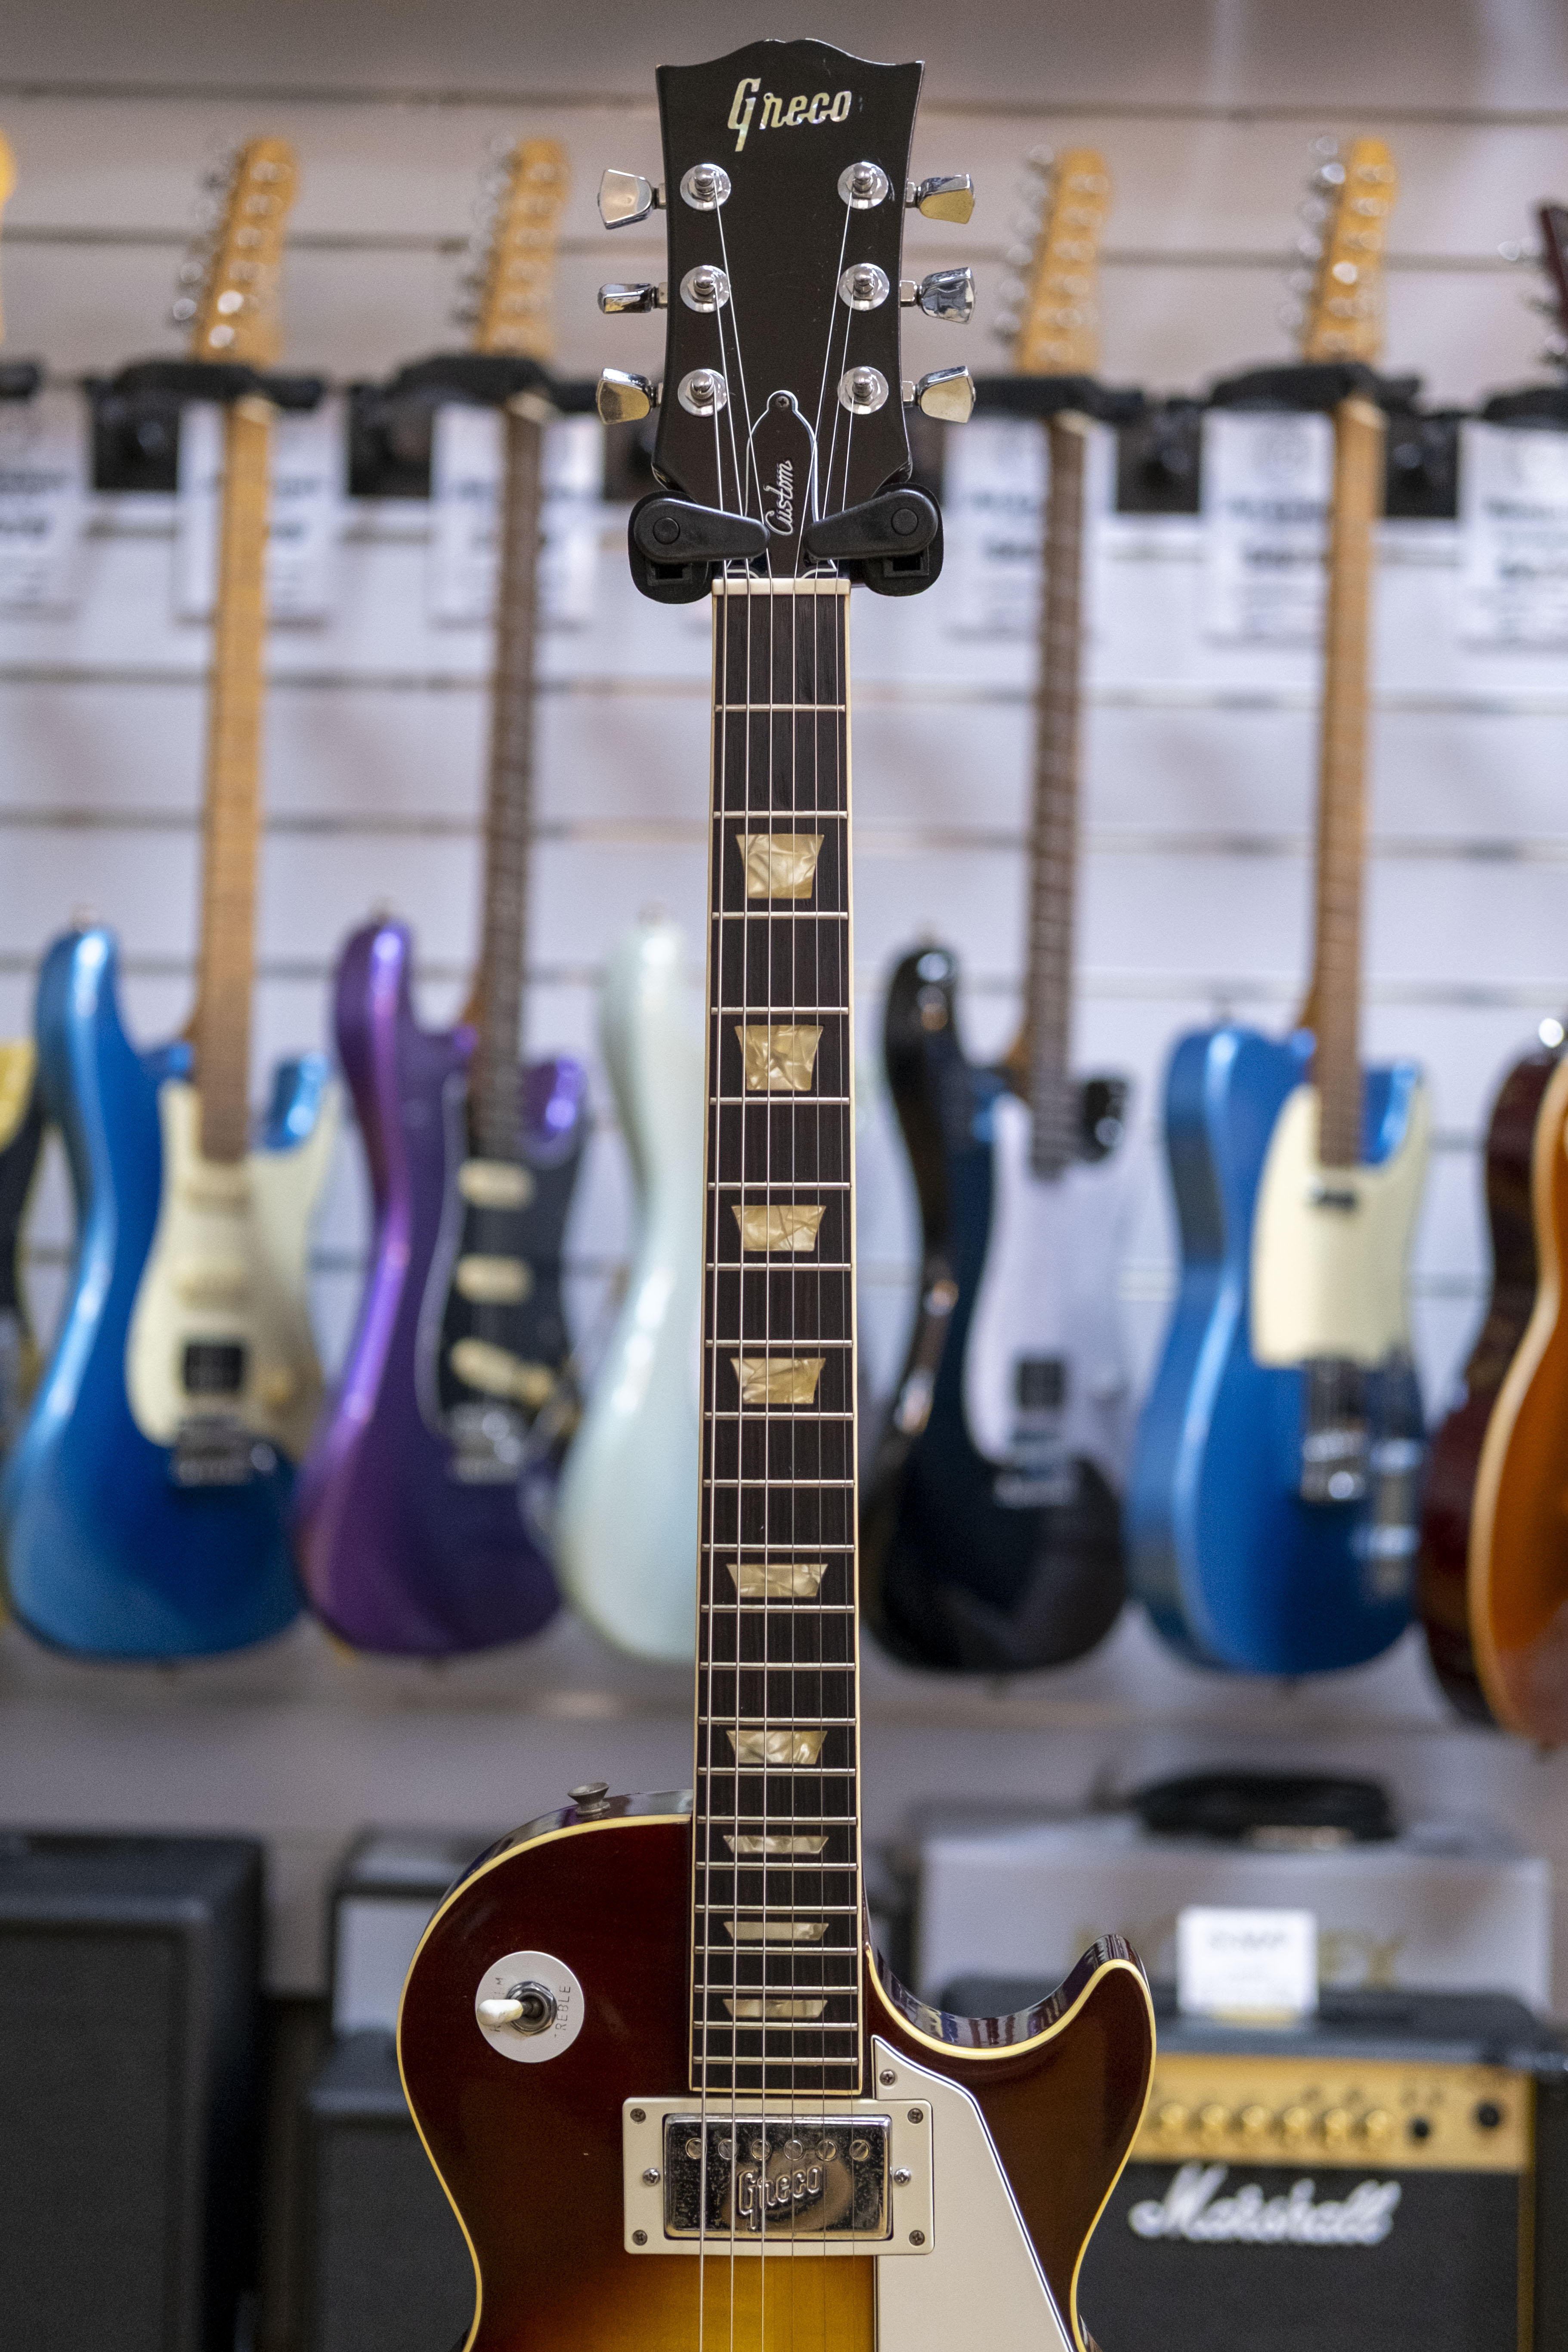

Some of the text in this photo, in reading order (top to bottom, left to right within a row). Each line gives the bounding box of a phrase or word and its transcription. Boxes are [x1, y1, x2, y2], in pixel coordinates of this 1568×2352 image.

[727, 77, 852, 152] Greco
[763, 460, 793, 535] Custom
[739, 2166, 823, 2231] Greco
[1129, 2161, 1401, 2244] Marshall
